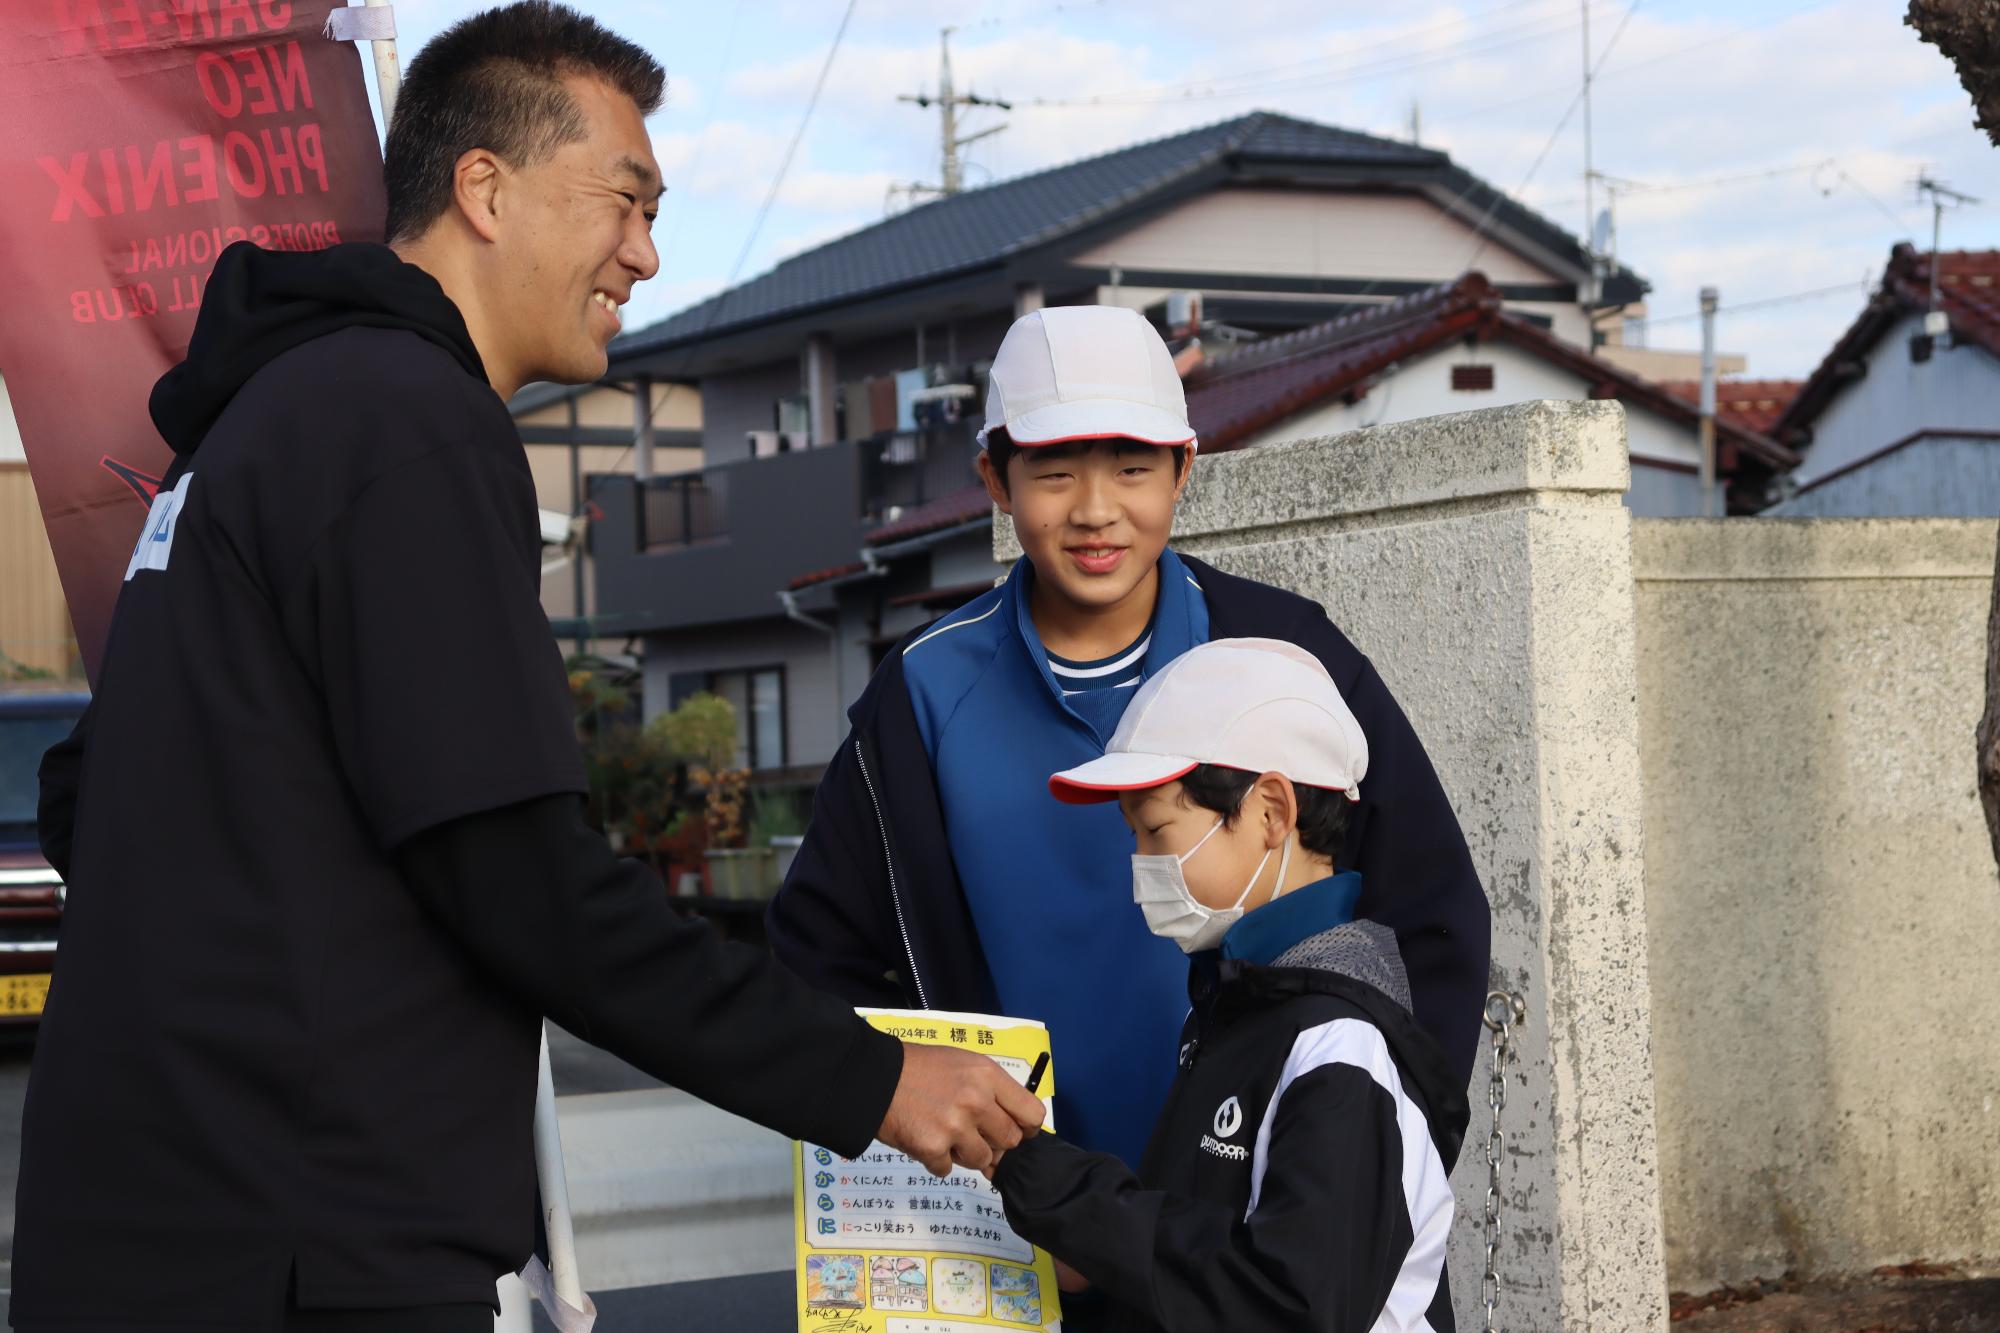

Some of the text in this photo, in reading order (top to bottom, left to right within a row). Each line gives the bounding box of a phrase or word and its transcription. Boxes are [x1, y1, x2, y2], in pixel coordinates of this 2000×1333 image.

[885, 1027, 938, 1040] 2024年度
[1200, 1134, 1245, 1160] OUTDOOR
[815, 1171, 835, 1188] か
[840, 1175, 894, 1187] かくにんだ
[817, 1193, 834, 1211] ら
[818, 1217, 1001, 1241] に にっこり笑おう ゆたかなえがお
